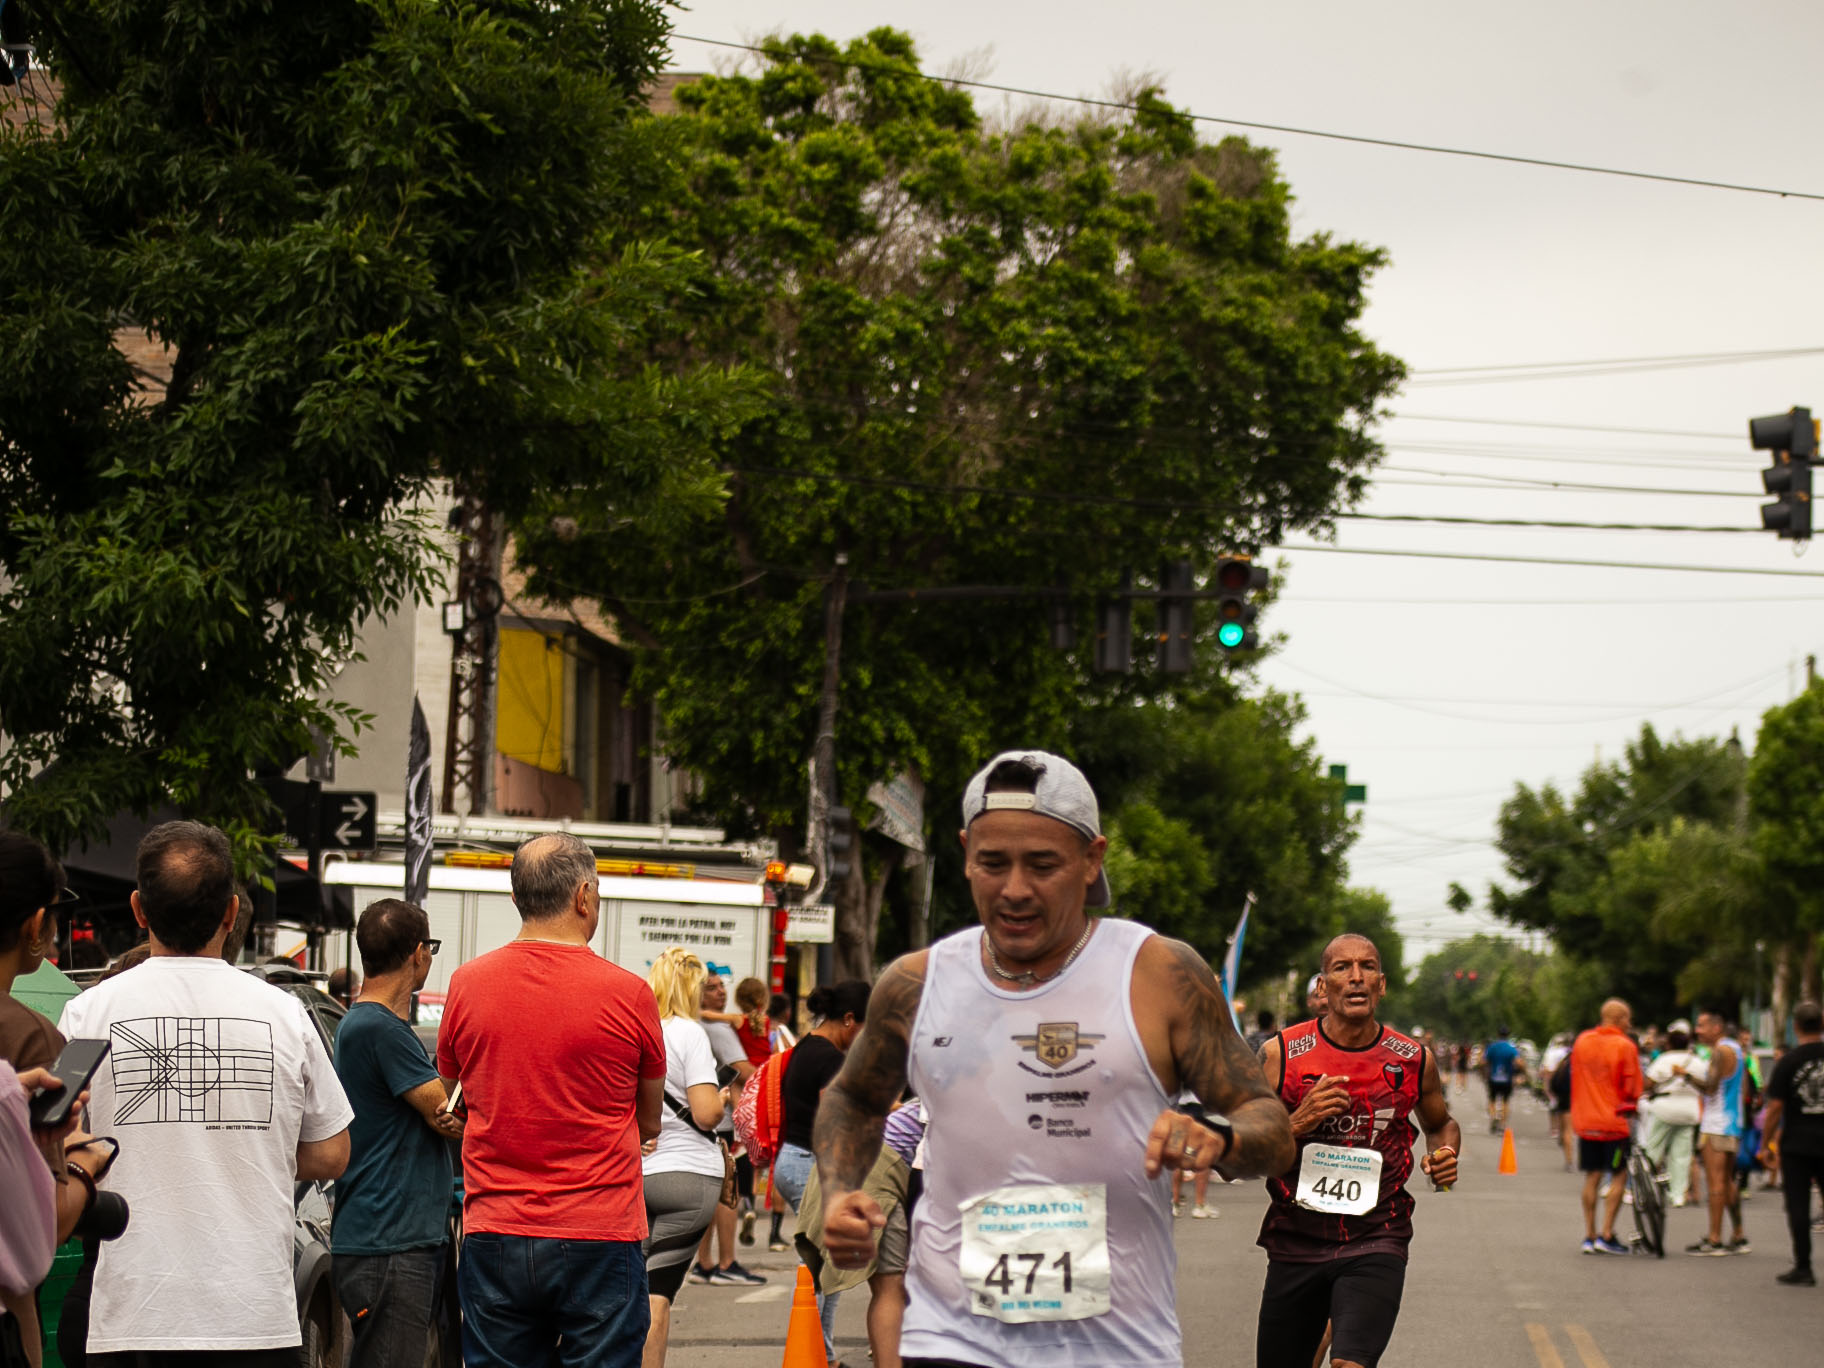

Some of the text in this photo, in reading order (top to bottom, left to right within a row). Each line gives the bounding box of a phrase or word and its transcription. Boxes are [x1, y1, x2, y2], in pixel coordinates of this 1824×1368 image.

[1045, 1046, 1068, 1059] 40
[1046, 1128, 1091, 1138] Municipal
[1315, 1151, 1370, 1164] 40 MARATON
[1311, 1176, 1362, 1202] 440
[982, 1202, 1083, 1216] 40 MARATON
[984, 1251, 1072, 1295] 471
